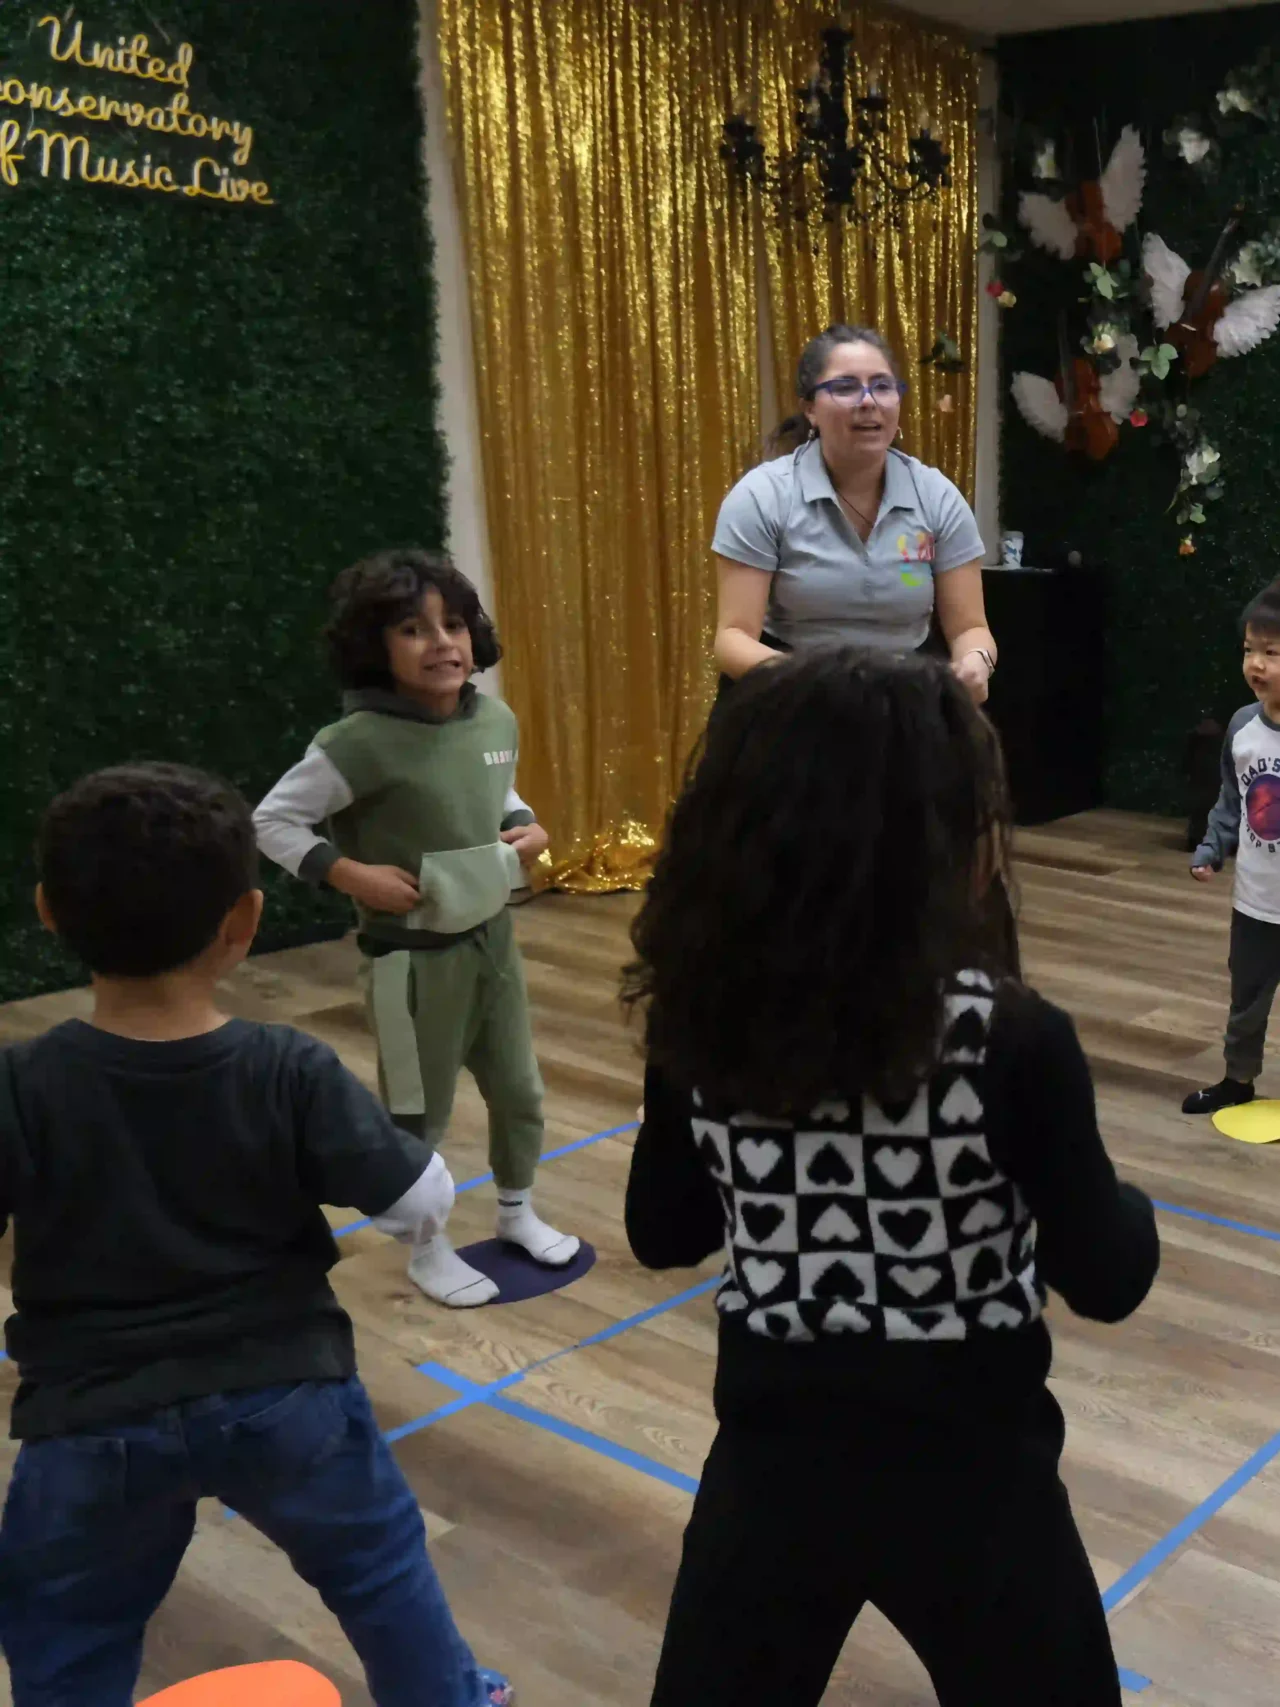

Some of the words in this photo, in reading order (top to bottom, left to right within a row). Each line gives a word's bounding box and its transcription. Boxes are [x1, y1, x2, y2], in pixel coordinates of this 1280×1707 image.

[38, 16, 193, 88] United
[0, 79, 252, 166] onservatory
[0, 120, 25, 186] f
[27, 129, 180, 190] Music
[183, 157, 274, 204] Live
